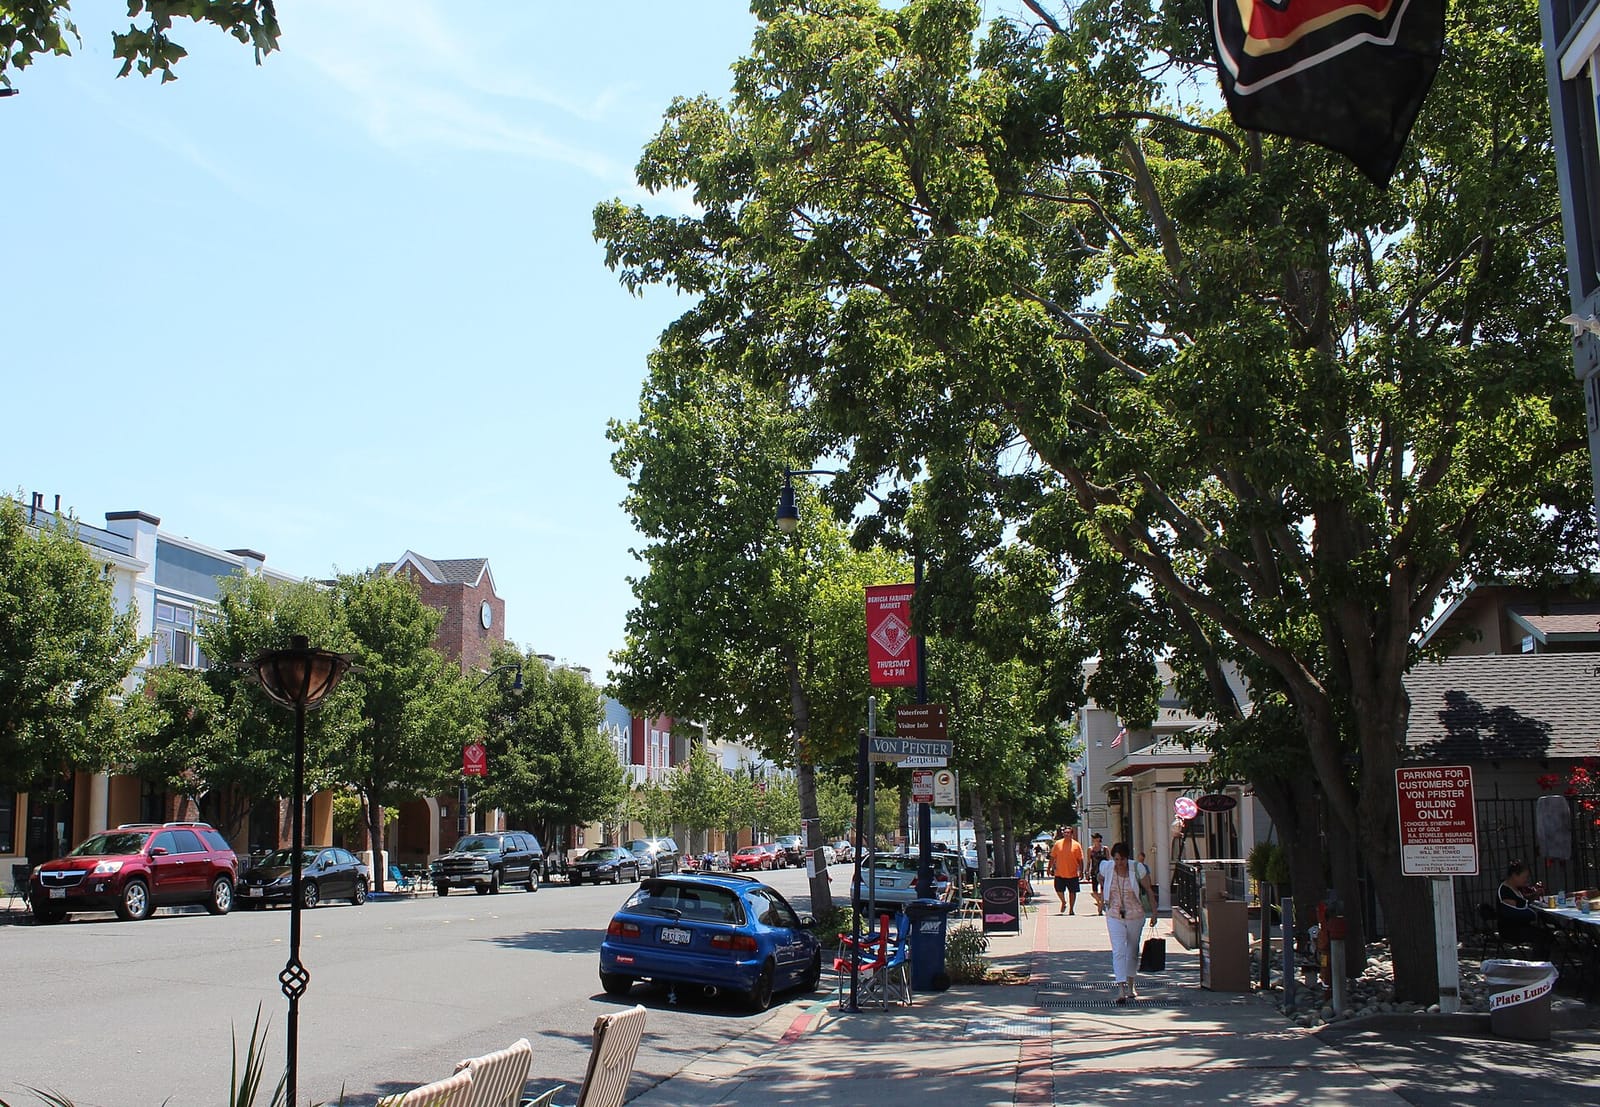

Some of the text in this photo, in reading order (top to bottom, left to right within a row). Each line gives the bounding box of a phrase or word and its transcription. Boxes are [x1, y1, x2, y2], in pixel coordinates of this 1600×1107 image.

[877, 659, 910, 669] THURSDAYS
[895, 668, 905, 676] PM
[874, 739, 948, 755] VON PFISTER
[1403, 769, 1463, 779] PARKING FOR
[1399, 779, 1470, 790] CUSTOMERS OF
[1406, 789, 1465, 799] VON PFISTER
[1415, 800, 1456, 809] BUILDING
[1418, 810, 1453, 820] ONLY!
[1496, 994, 1521, 1006] Plate
